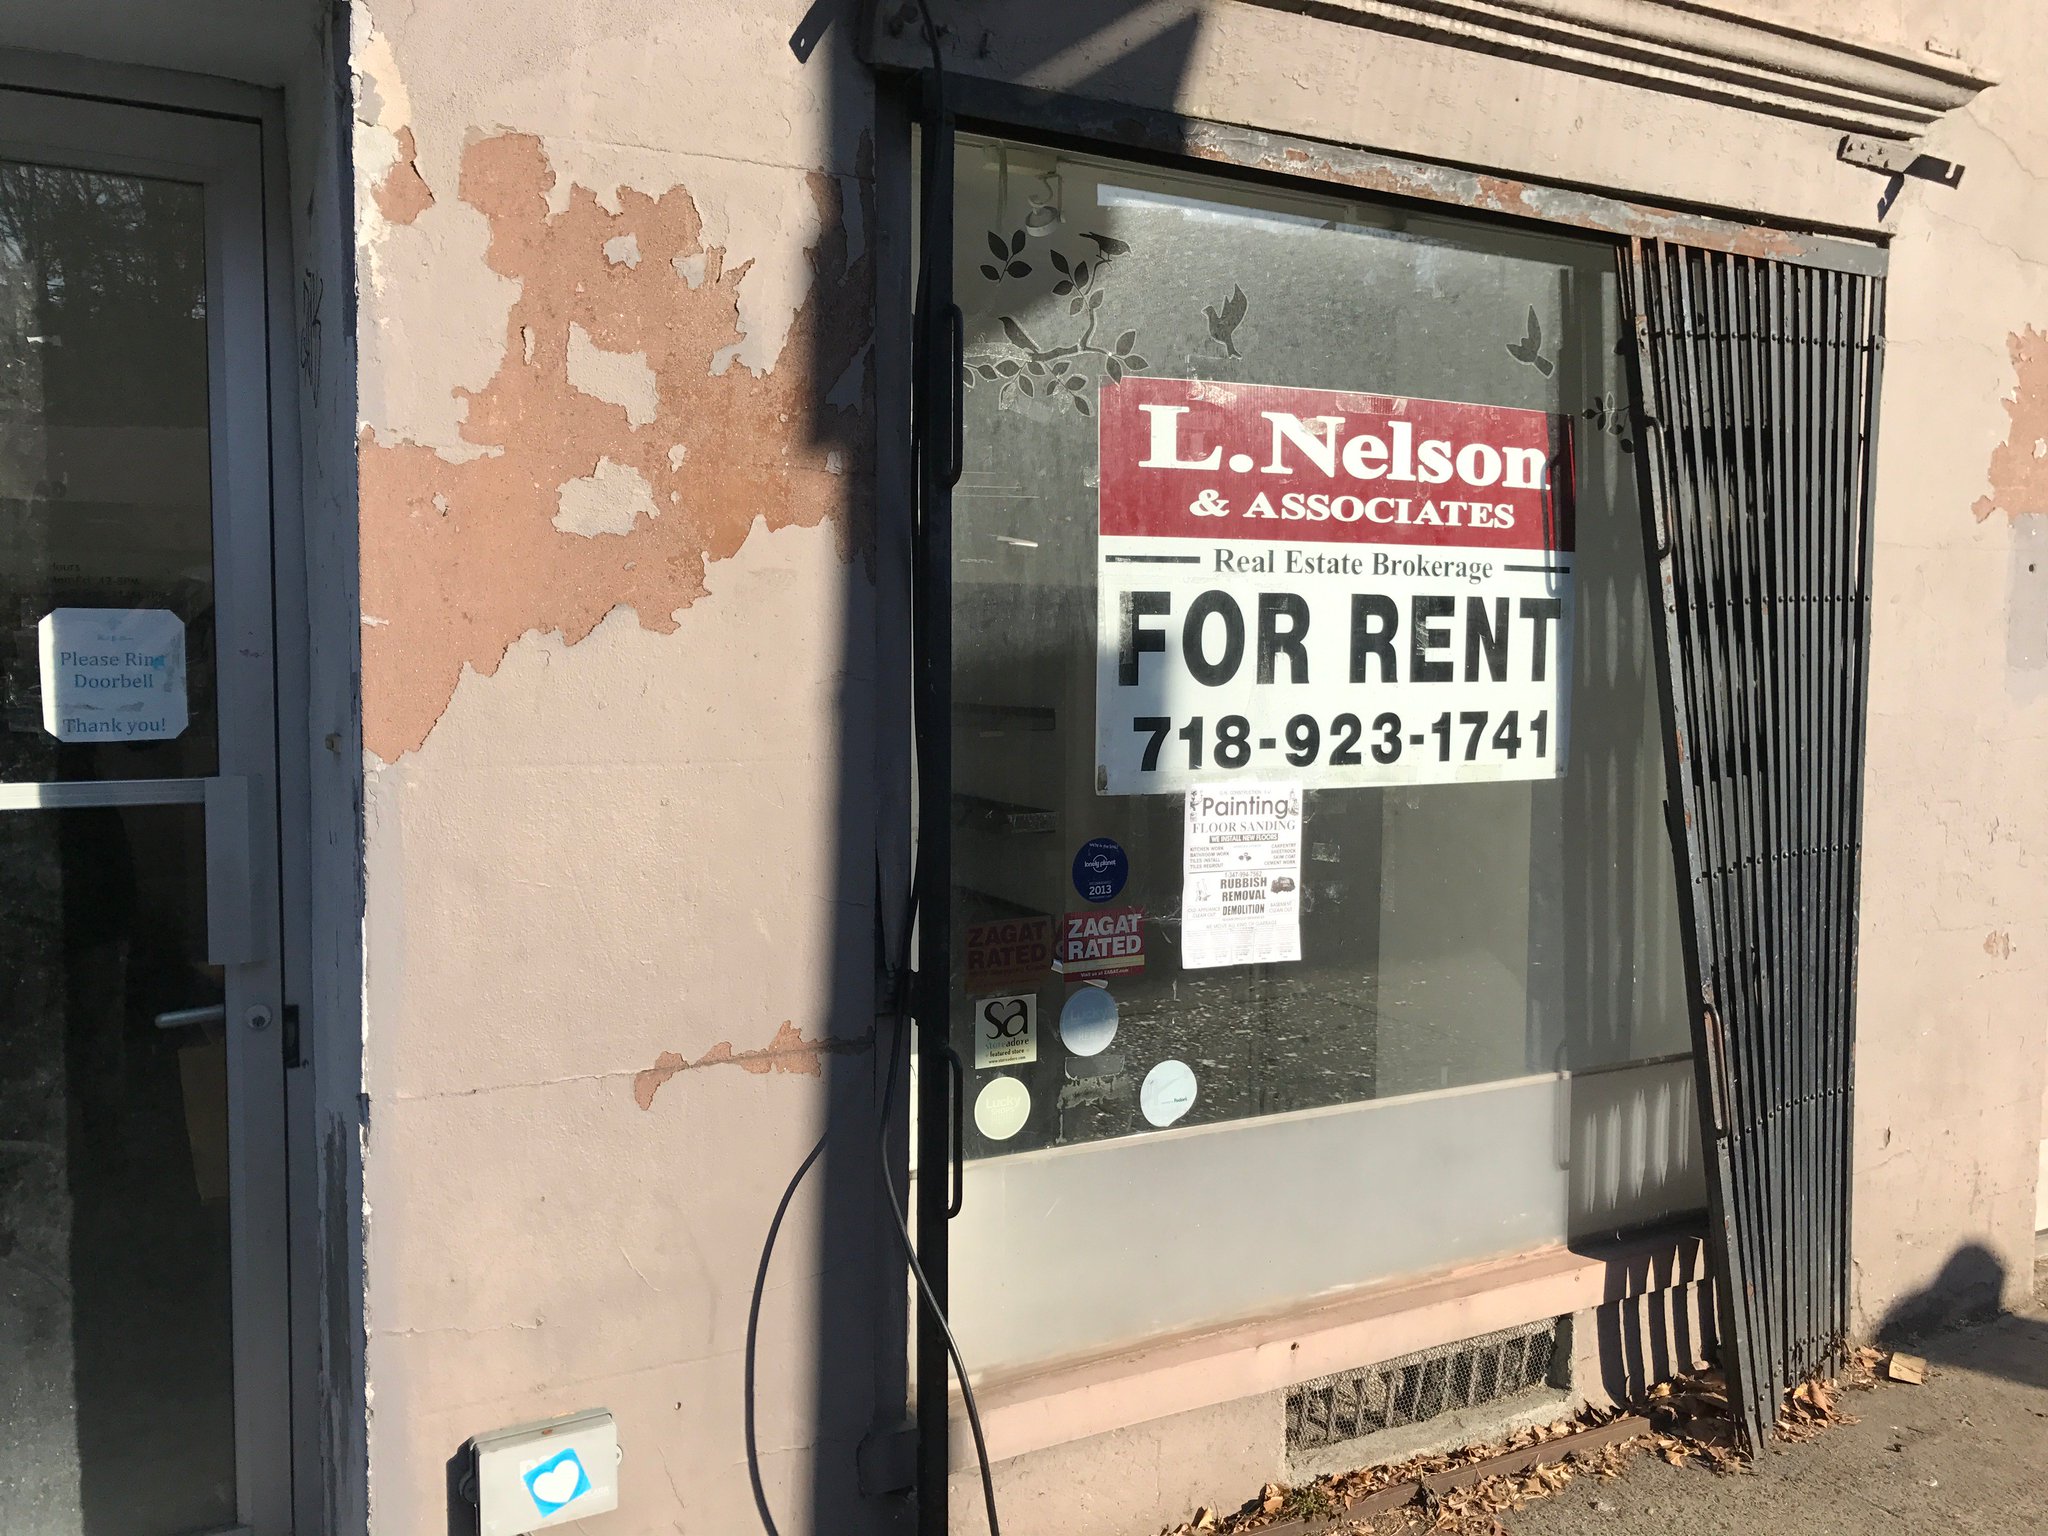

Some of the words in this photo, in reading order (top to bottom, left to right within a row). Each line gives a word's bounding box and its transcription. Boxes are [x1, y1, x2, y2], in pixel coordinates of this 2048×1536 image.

[1189, 488, 1231, 518] &
[1242, 491, 1515, 529] ASSOCIATES
[1213, 547, 1275, 575] Real
[1283, 549, 1363, 577] Estate
[1371, 551, 1494, 585] Brokerage
[1117, 589, 1311, 687] FOR
[1349, 592, 1562, 684] RENT
[60, 651, 119, 667] Please
[74, 673, 153, 689] Doorbell
[62, 717, 122, 733] Thank
[126, 717, 166, 736] you!
[1133, 709, 1548, 772] 718-923-1741
[1202, 796, 1288, 819] Painting
[1193, 822, 1236, 834] FLOOR
[1240, 820, 1296, 833] SANDING
[1242, 834, 1256, 842] NEW
[1100, 859, 1116, 868] planet
[1089, 885, 1112, 896] 2013
[1220, 877, 1267, 889] RUBBISH
[1222, 890, 1266, 902] REMOVAL
[1222, 903, 1265, 916] DEMOLITION
[968, 921, 1047, 947] ZAGAT
[1068, 913, 1142, 939] ZAGAT
[968, 944, 1047, 969] RATED
[1068, 935, 1141, 961] RATED
[989, 1049, 1011, 1058] featured
